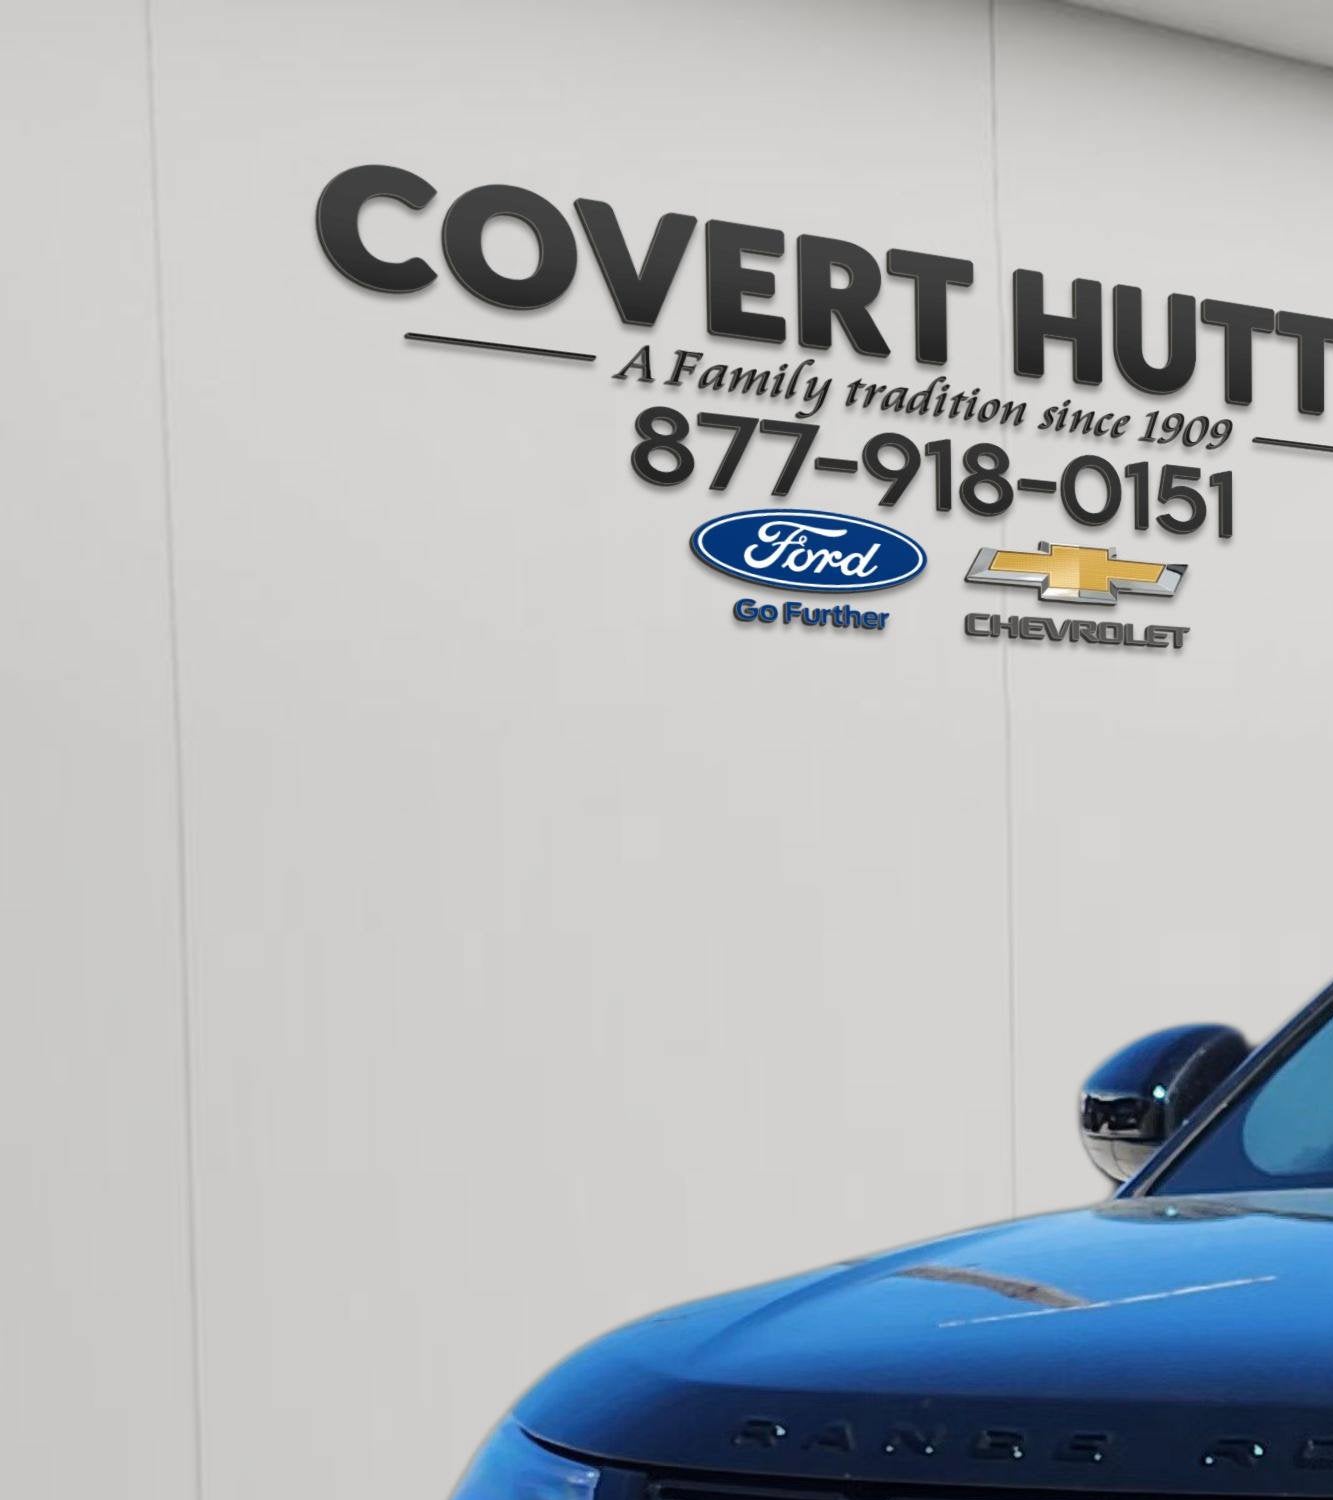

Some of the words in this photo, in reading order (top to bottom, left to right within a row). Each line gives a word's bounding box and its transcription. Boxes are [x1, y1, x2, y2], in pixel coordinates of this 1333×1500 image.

[316, 165, 975, 367] COVERT
[612, 345, 655, 384] A
[663, 349, 833, 420] Family
[845, 376, 1027, 427] tradition
[1036, 398, 1131, 440] since
[1138, 409, 1234, 450] 1909
[630, 406, 1234, 540] 877-918-0151
[743, 520, 882, 580] Ford
[733, 598, 778, 624] Go
[782, 601, 890, 631] Further
[964, 612, 1190, 650] CHEVROLET
